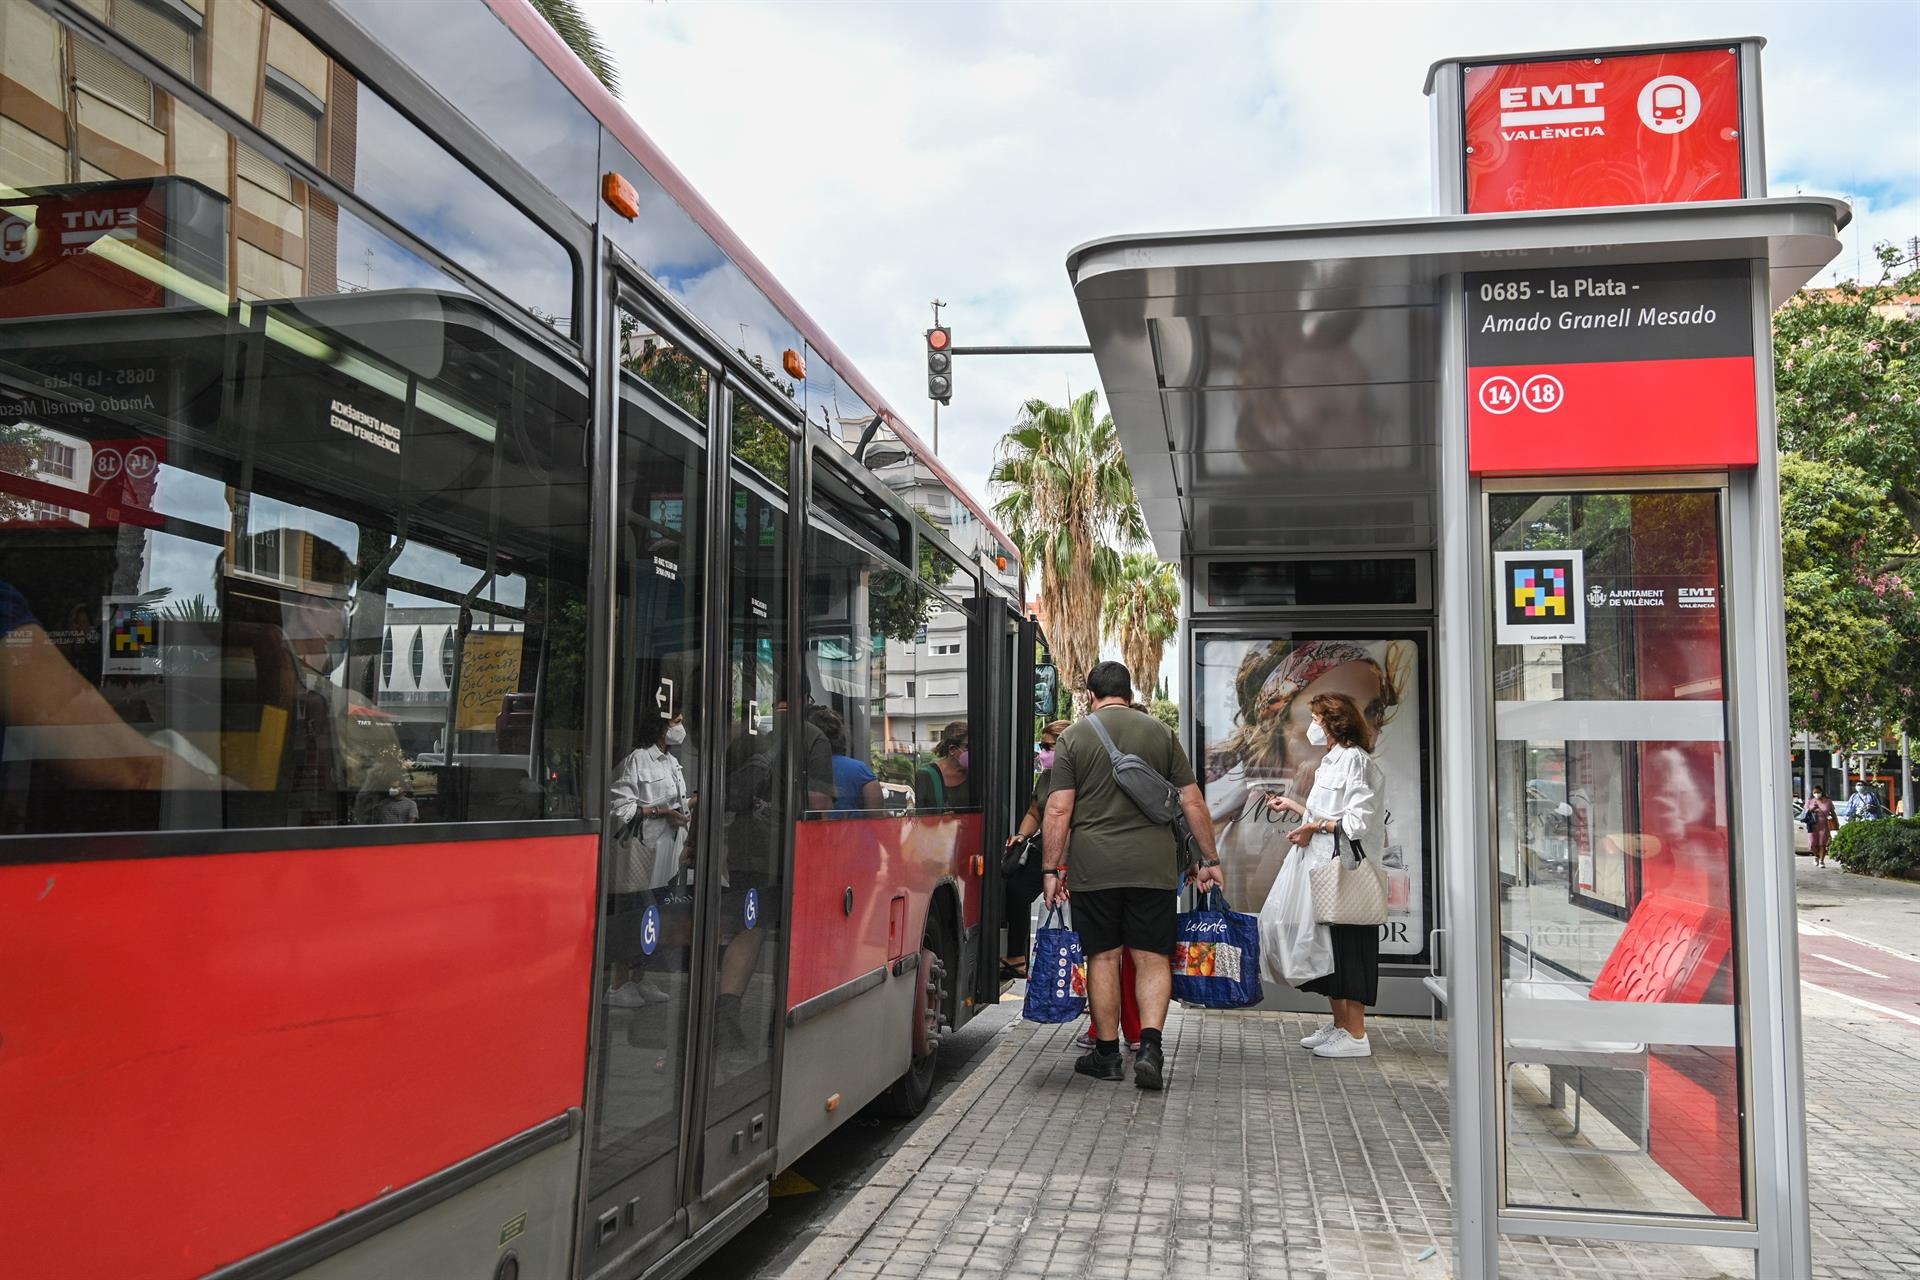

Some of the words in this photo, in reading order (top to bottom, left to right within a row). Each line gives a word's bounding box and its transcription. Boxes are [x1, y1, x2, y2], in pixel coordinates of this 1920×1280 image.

[1500, 82, 1604, 108] EMT
[1501, 125, 1605, 141] VALÈNCIA
[1480, 281, 1531, 301] 0685
[1550, 280, 1569, 299] la
[1575, 278, 1626, 297] Plata
[1482, 311, 1551, 333] Amado
[1558, 308, 1630, 330] Granell
[1637, 305, 1716, 326] Mesado
[1489, 386, 1512, 406] 14
[1531, 383, 1555, 403] 18
[1609, 589, 1665, 598] AJUNTAMENT
[1678, 588, 1715, 596] EMT
[1623, 598, 1665, 606] VALÈNCIA
[1185, 918, 1228, 935] Levante
